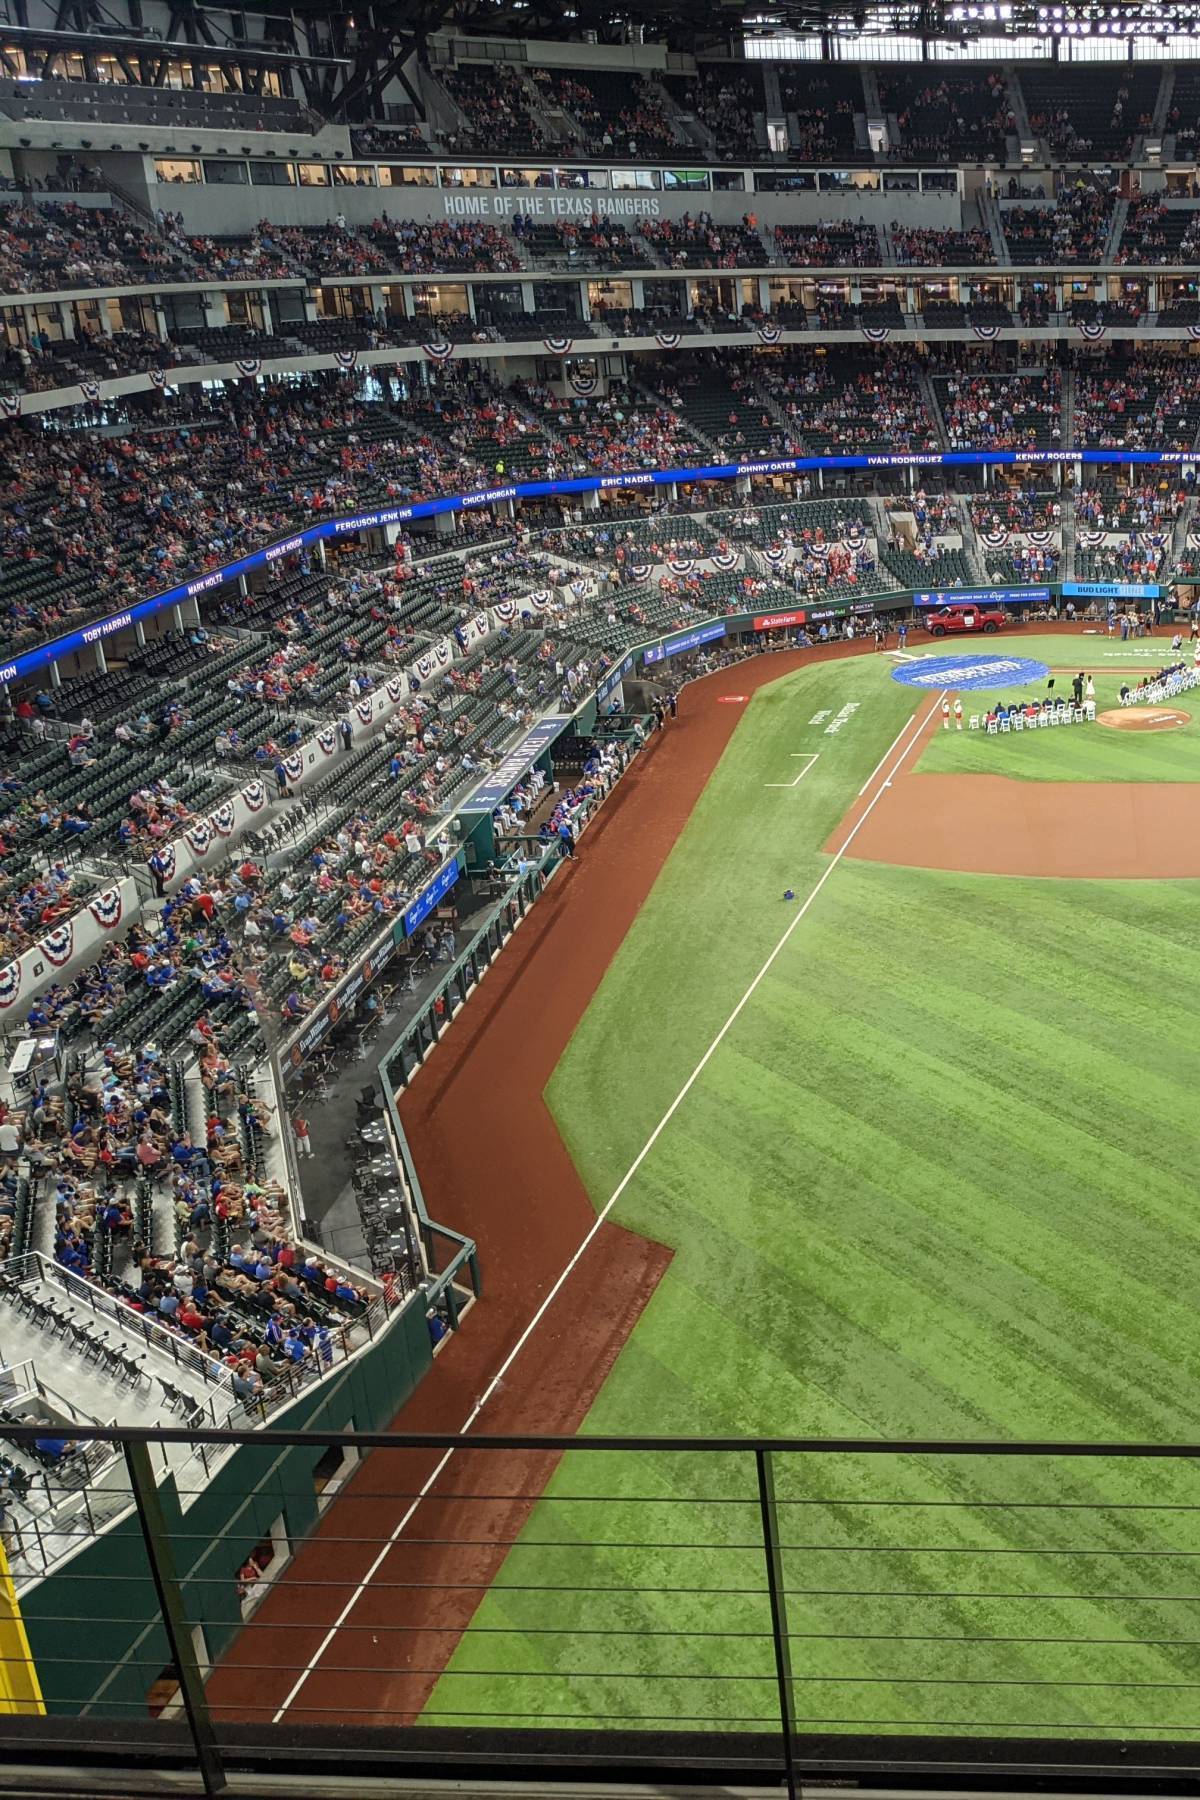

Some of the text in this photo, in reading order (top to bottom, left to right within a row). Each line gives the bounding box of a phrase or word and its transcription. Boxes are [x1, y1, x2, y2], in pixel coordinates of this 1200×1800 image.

[444, 196, 660, 215] HOME OF THE TEXAS RANGERS
[1016, 452, 1082, 461] KENNY ROGERS
[1159, 453, 1181, 462] JEFF
[736, 462, 797, 474] JOHNNY OATES
[601, 475, 655, 487] ERIC NADEL
[462, 489, 516, 506] CHUCK MORGAN
[335, 508, 413, 532] FERGUSON JENKINS
[265, 538, 303, 561] CHARLIE HOUGH
[187, 573, 223, 597] MARK HOLTZ
[1096, 586, 1119, 594] LIGHT
[82, 614, 132, 643] TOBY HARRAH
[484, 736, 549, 788] TEXAS RANGERS
